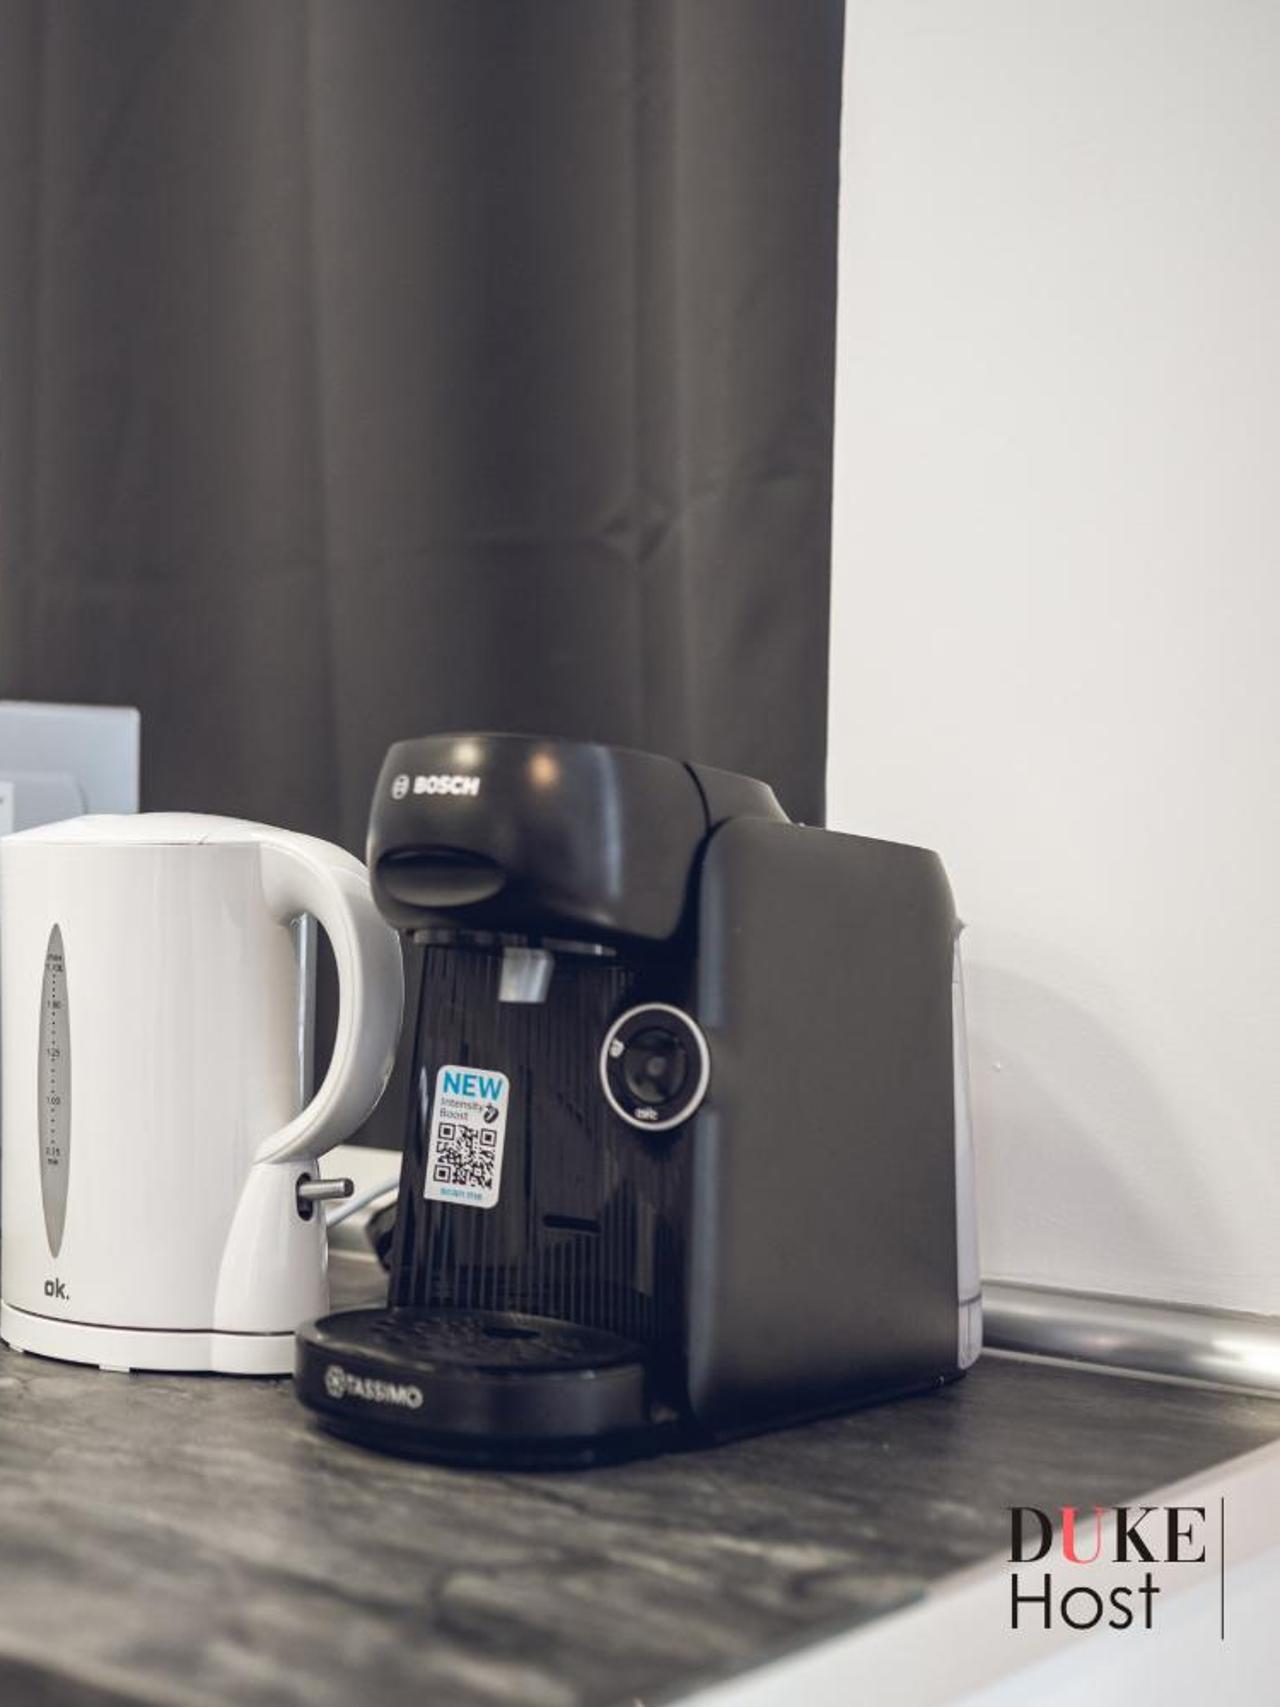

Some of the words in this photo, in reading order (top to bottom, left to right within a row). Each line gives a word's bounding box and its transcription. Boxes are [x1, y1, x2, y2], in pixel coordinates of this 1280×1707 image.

[413, 775, 480, 796] BOSCH
[442, 1072, 503, 1101] NEW
[440, 1097, 483, 1113] Intensity
[440, 1108, 469, 1121] Boost
[346, 1373, 423, 1409] TASSIMO
